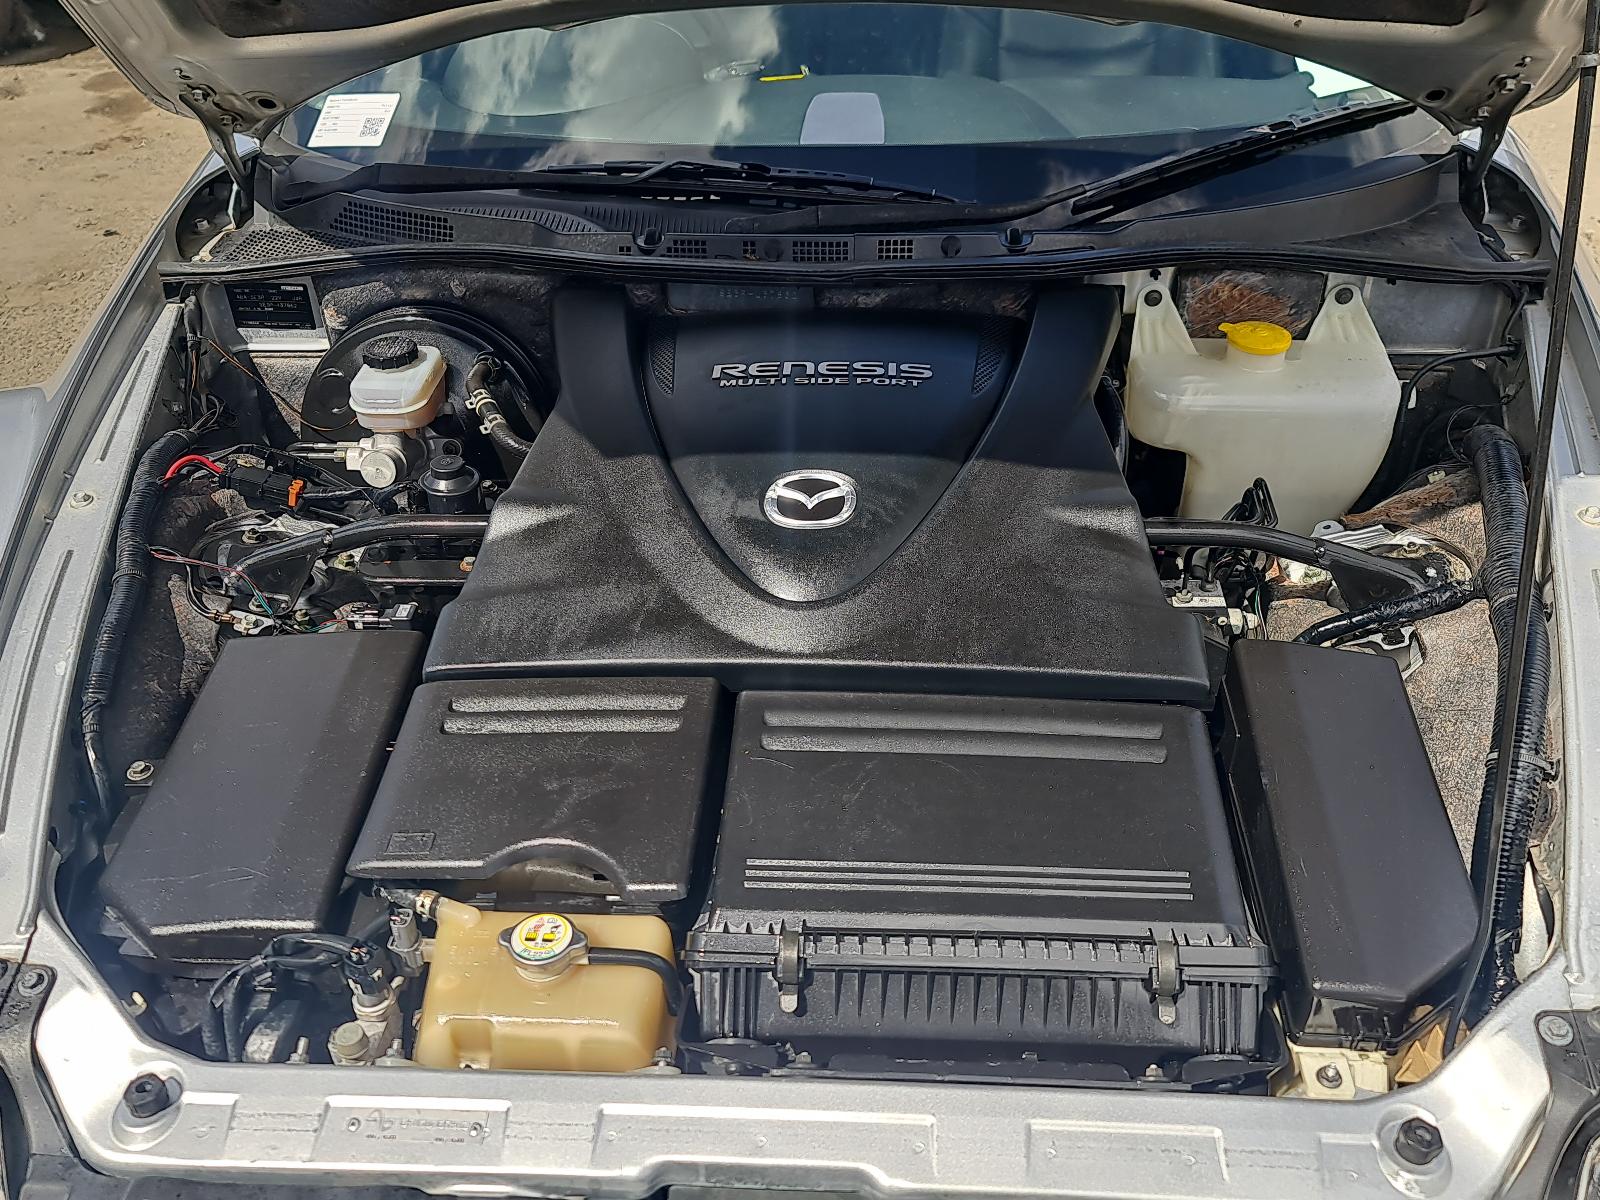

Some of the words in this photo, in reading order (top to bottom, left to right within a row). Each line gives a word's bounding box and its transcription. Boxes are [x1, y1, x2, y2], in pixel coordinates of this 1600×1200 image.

[711, 361, 934, 379] RENESIS
[719, 377, 787, 387] MULTI
[794, 377, 850, 385] SIDE
[856, 377, 924, 387] PORT
